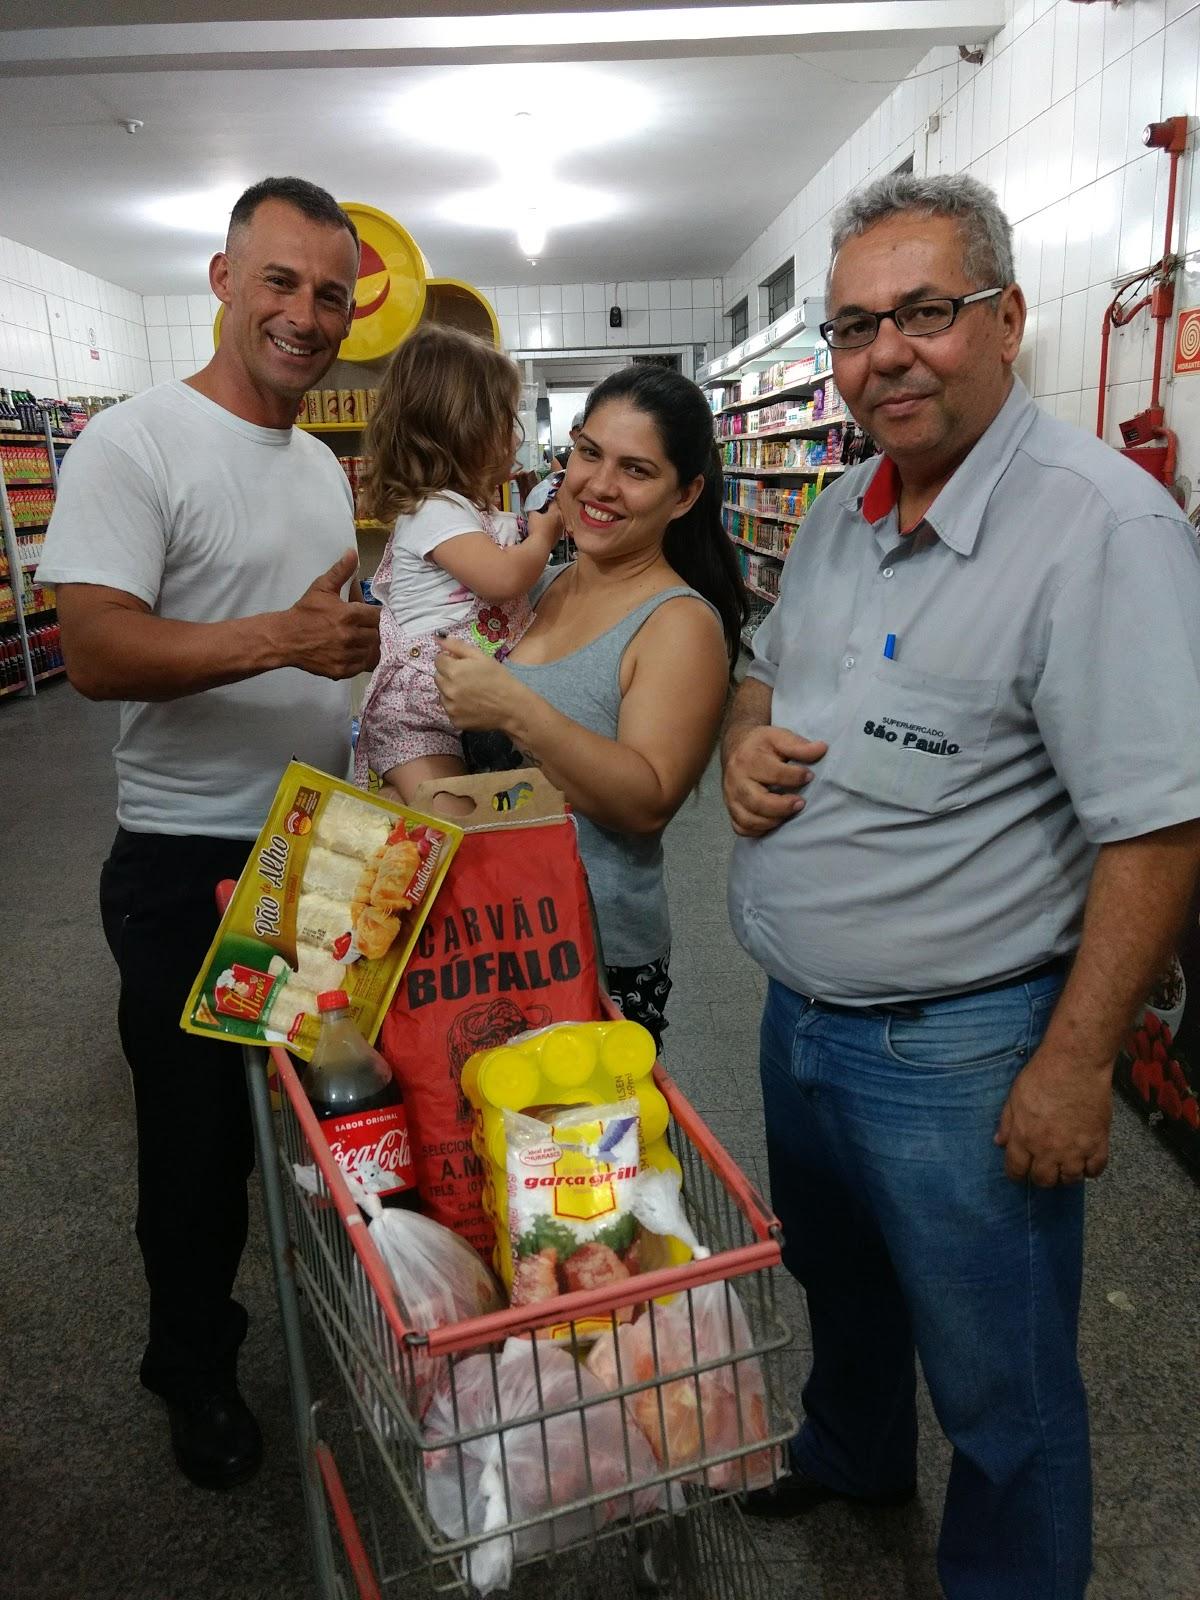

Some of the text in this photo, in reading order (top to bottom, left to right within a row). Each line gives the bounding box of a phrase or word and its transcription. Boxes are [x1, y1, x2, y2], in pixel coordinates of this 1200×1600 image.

[863, 720, 960, 755] São Paulo
[882, 716, 945, 738] SUPERMERCADO
[256, 834, 289, 890] Alho
[405, 838, 443, 905] Tradicional
[253, 895, 281, 938] Pão
[419, 896, 559, 960] CARVÃO
[407, 940, 582, 1009] BÚFALO
[335, 1113, 398, 1133] SABOR ORIGINAL
[423, 1139, 473, 1156] SELECION
[523, 1175, 585, 1190] garça
[588, 1165, 638, 1187] grill
